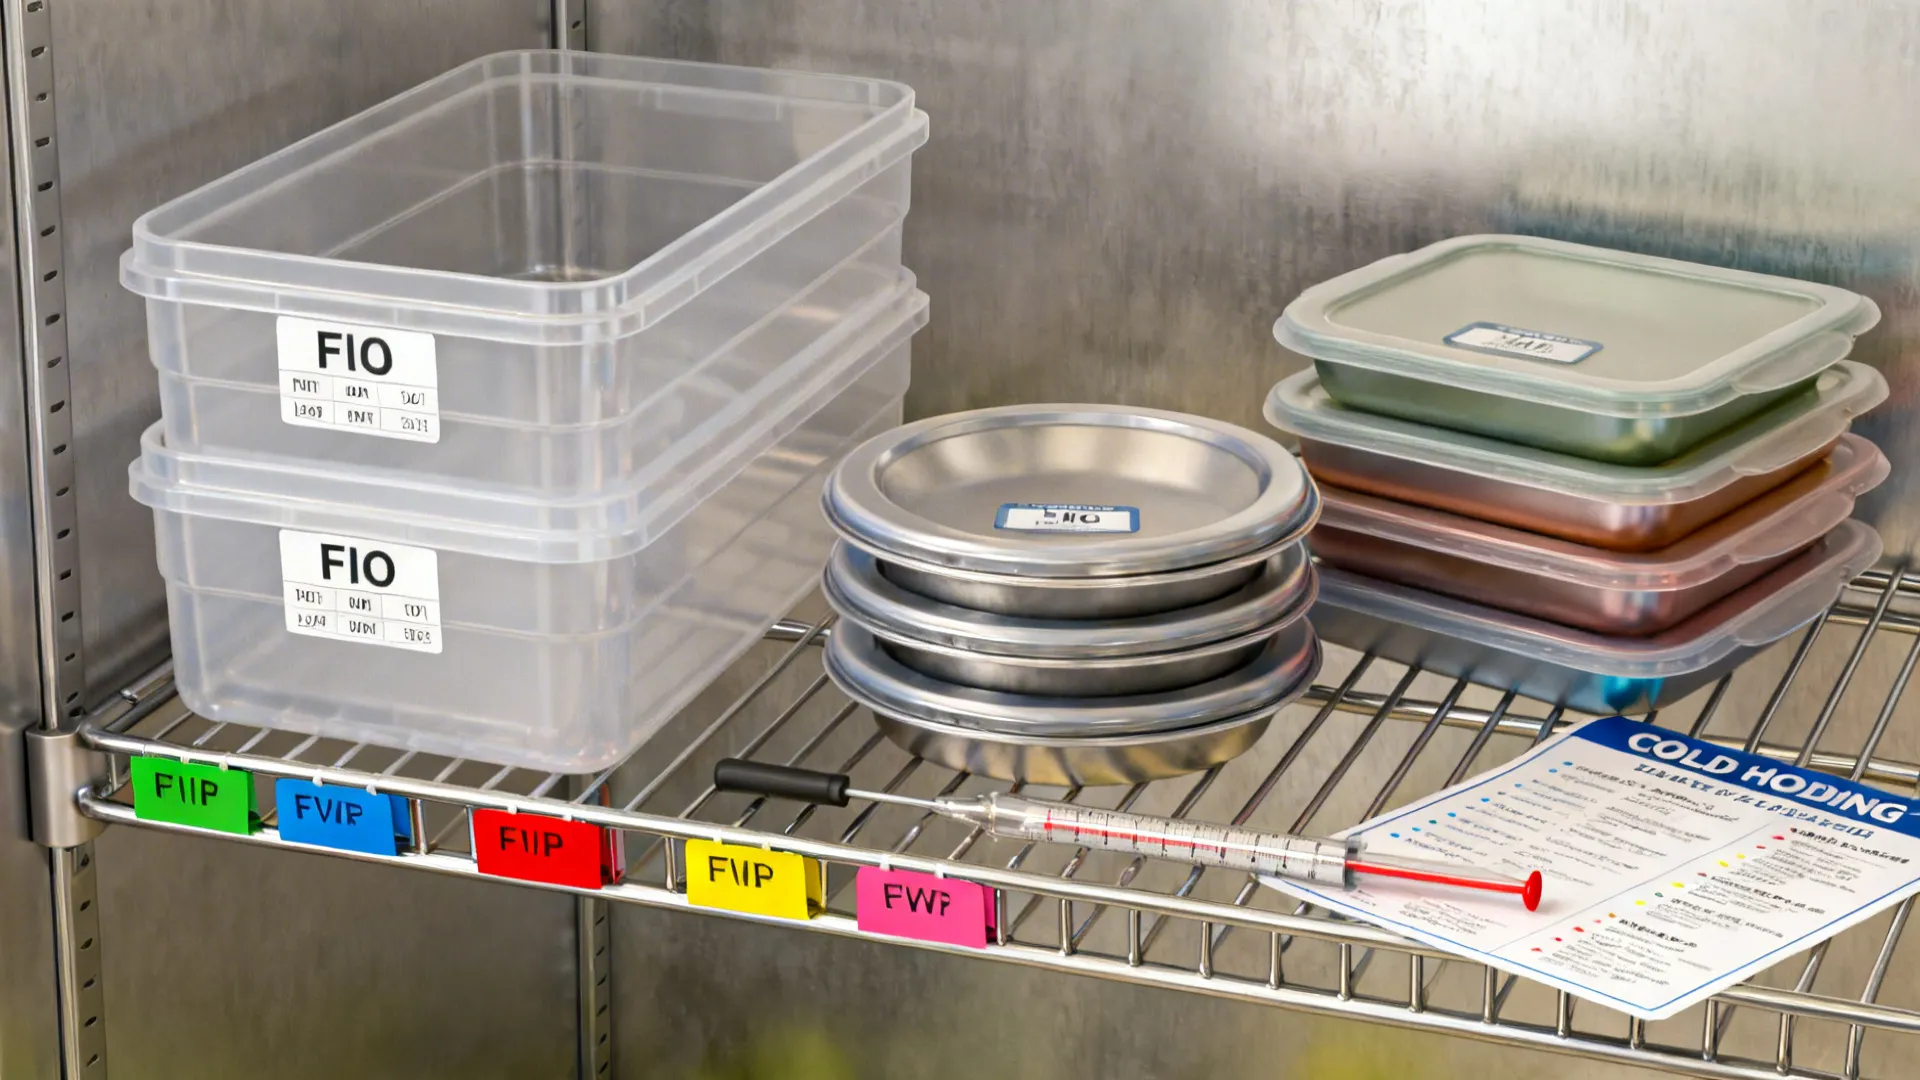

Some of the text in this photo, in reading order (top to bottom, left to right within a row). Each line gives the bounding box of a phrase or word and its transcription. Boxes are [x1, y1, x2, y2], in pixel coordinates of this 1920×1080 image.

[317, 330, 393, 376] FIO
[320, 542, 396, 588] FIO
[1627, 732, 1740, 775] COLD
[1741, 764, 1908, 824] HODING
